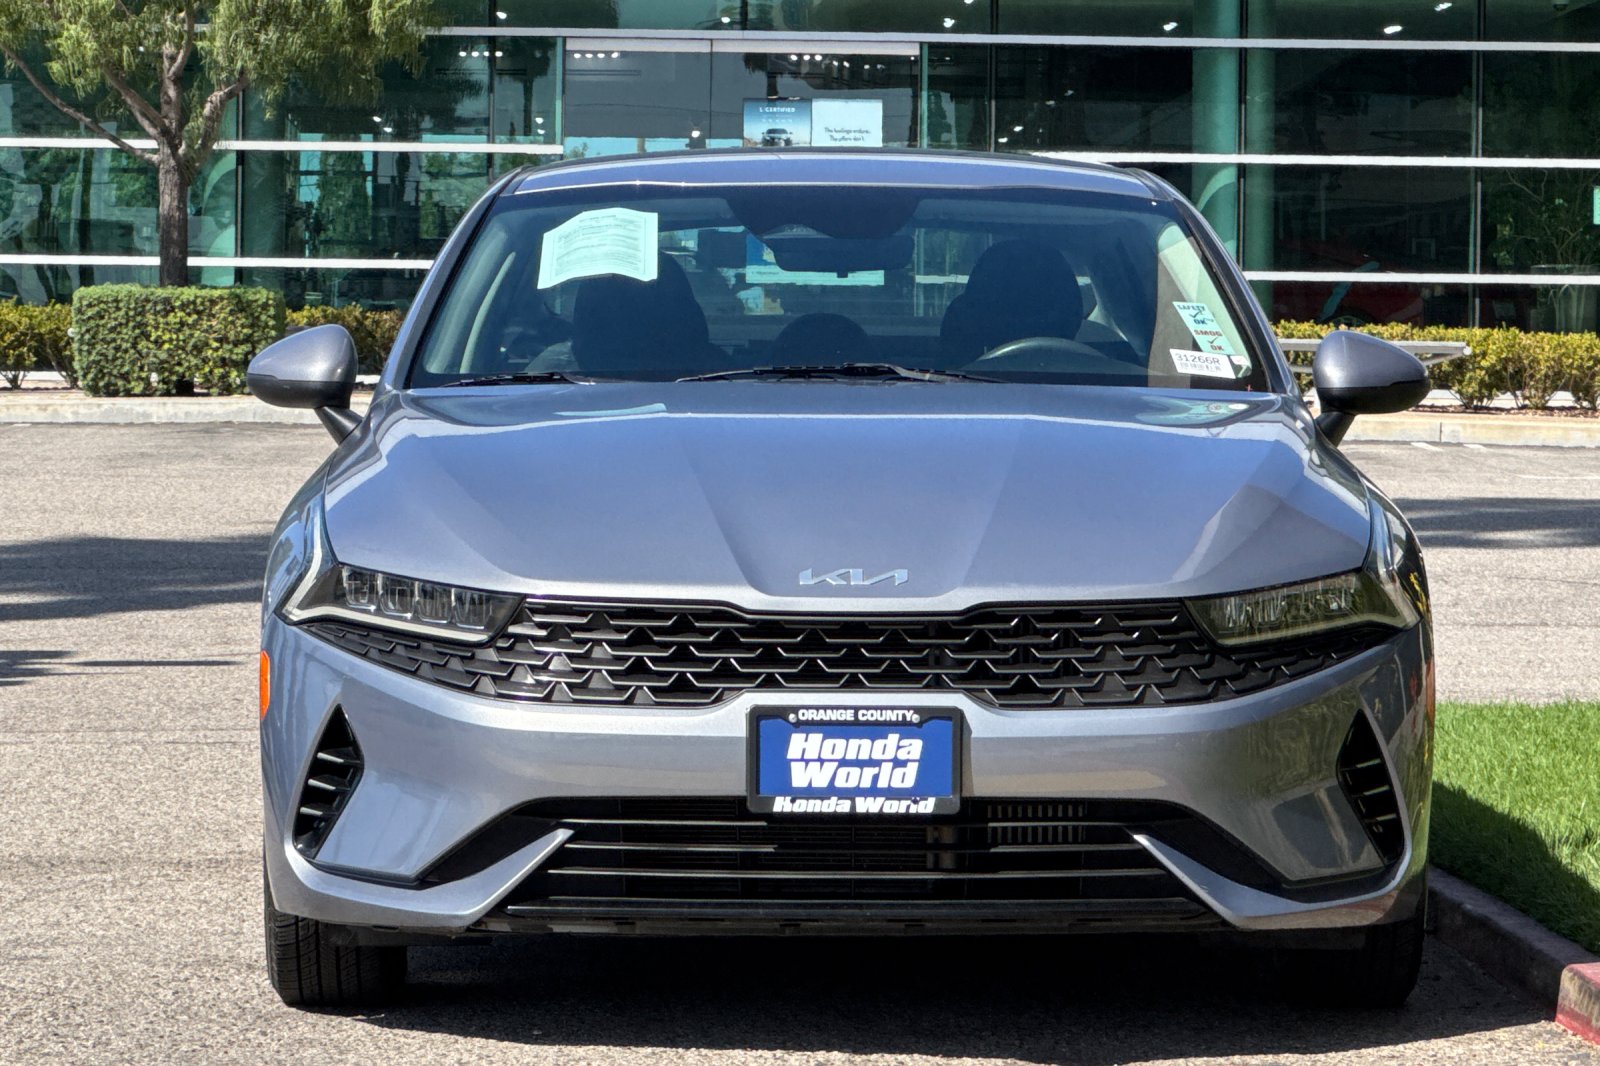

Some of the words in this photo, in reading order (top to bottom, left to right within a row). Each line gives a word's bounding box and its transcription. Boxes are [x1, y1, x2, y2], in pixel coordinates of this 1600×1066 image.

[1177, 304, 1206, 312] SAFETY
[1175, 353, 1221, 365] 31266R
[799, 568, 908, 586] KIA
[798, 709, 855, 721] ORANGE
[858, 709, 914, 722] COUNTY
[787, 733, 923, 760] Honda
[790, 761, 919, 788] World
[773, 797, 851, 813] Honda
[855, 797, 936, 814] World
